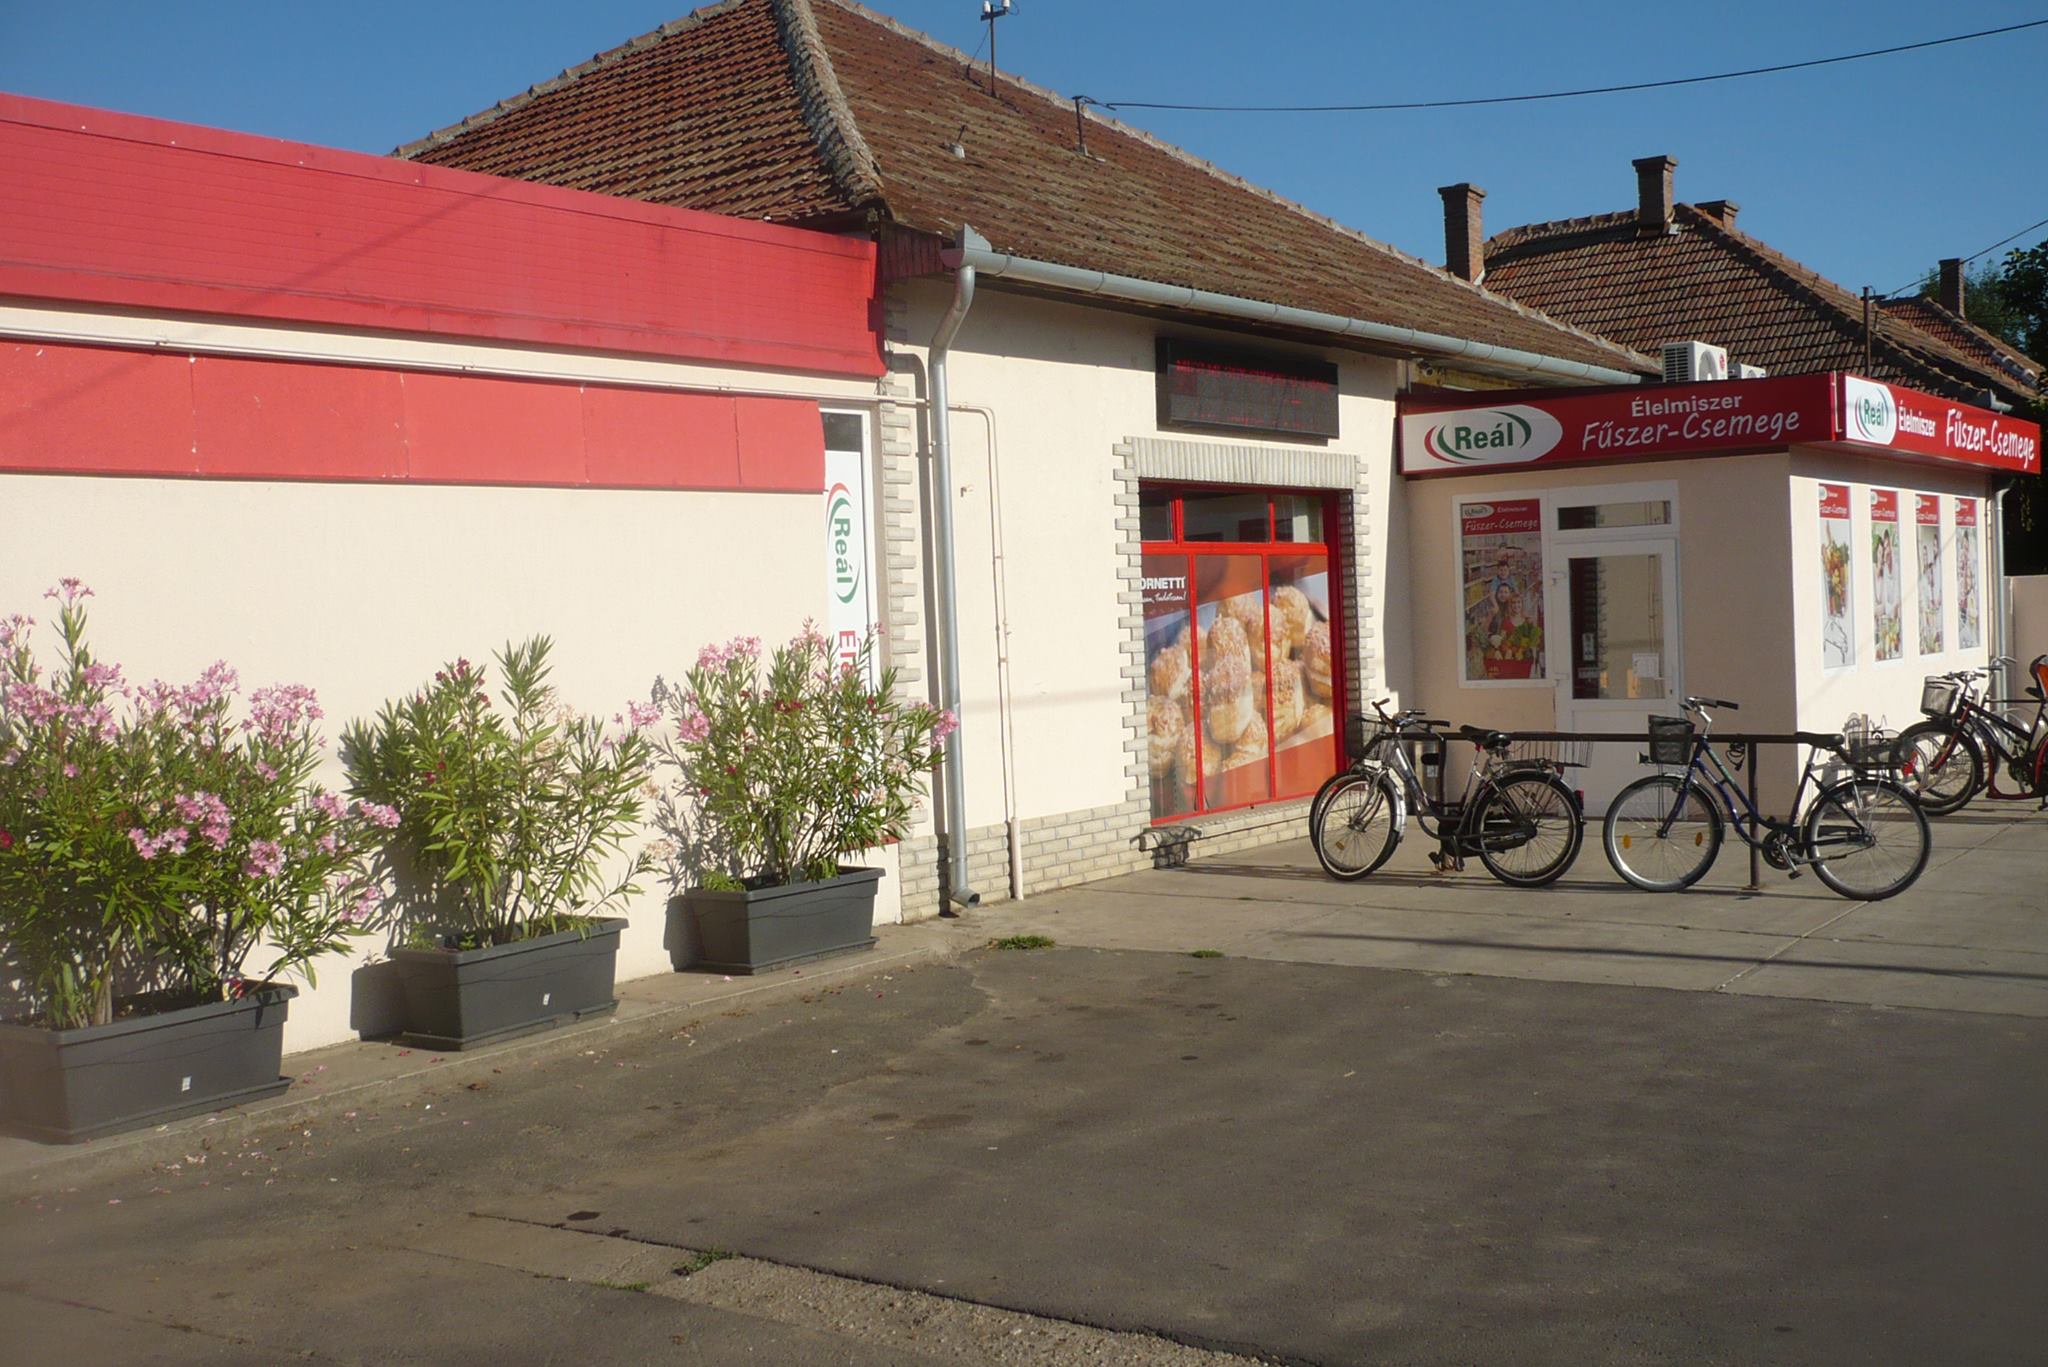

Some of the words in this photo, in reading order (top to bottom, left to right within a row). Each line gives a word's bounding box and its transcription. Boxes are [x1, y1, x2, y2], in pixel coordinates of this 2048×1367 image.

[1631, 394, 1743, 418] Élelmiszer
[1863, 398, 1885, 427] Reál
[1898, 400, 1937, 438] Élelmiszer
[1454, 421, 1515, 451] Reál
[1581, 408, 1801, 452] Fűszer-Csemege
[1946, 408, 2035, 469] Fűszer-Csemege
[833, 517, 854, 584] Reál
[1140, 576, 1186, 590] ORNETTI
